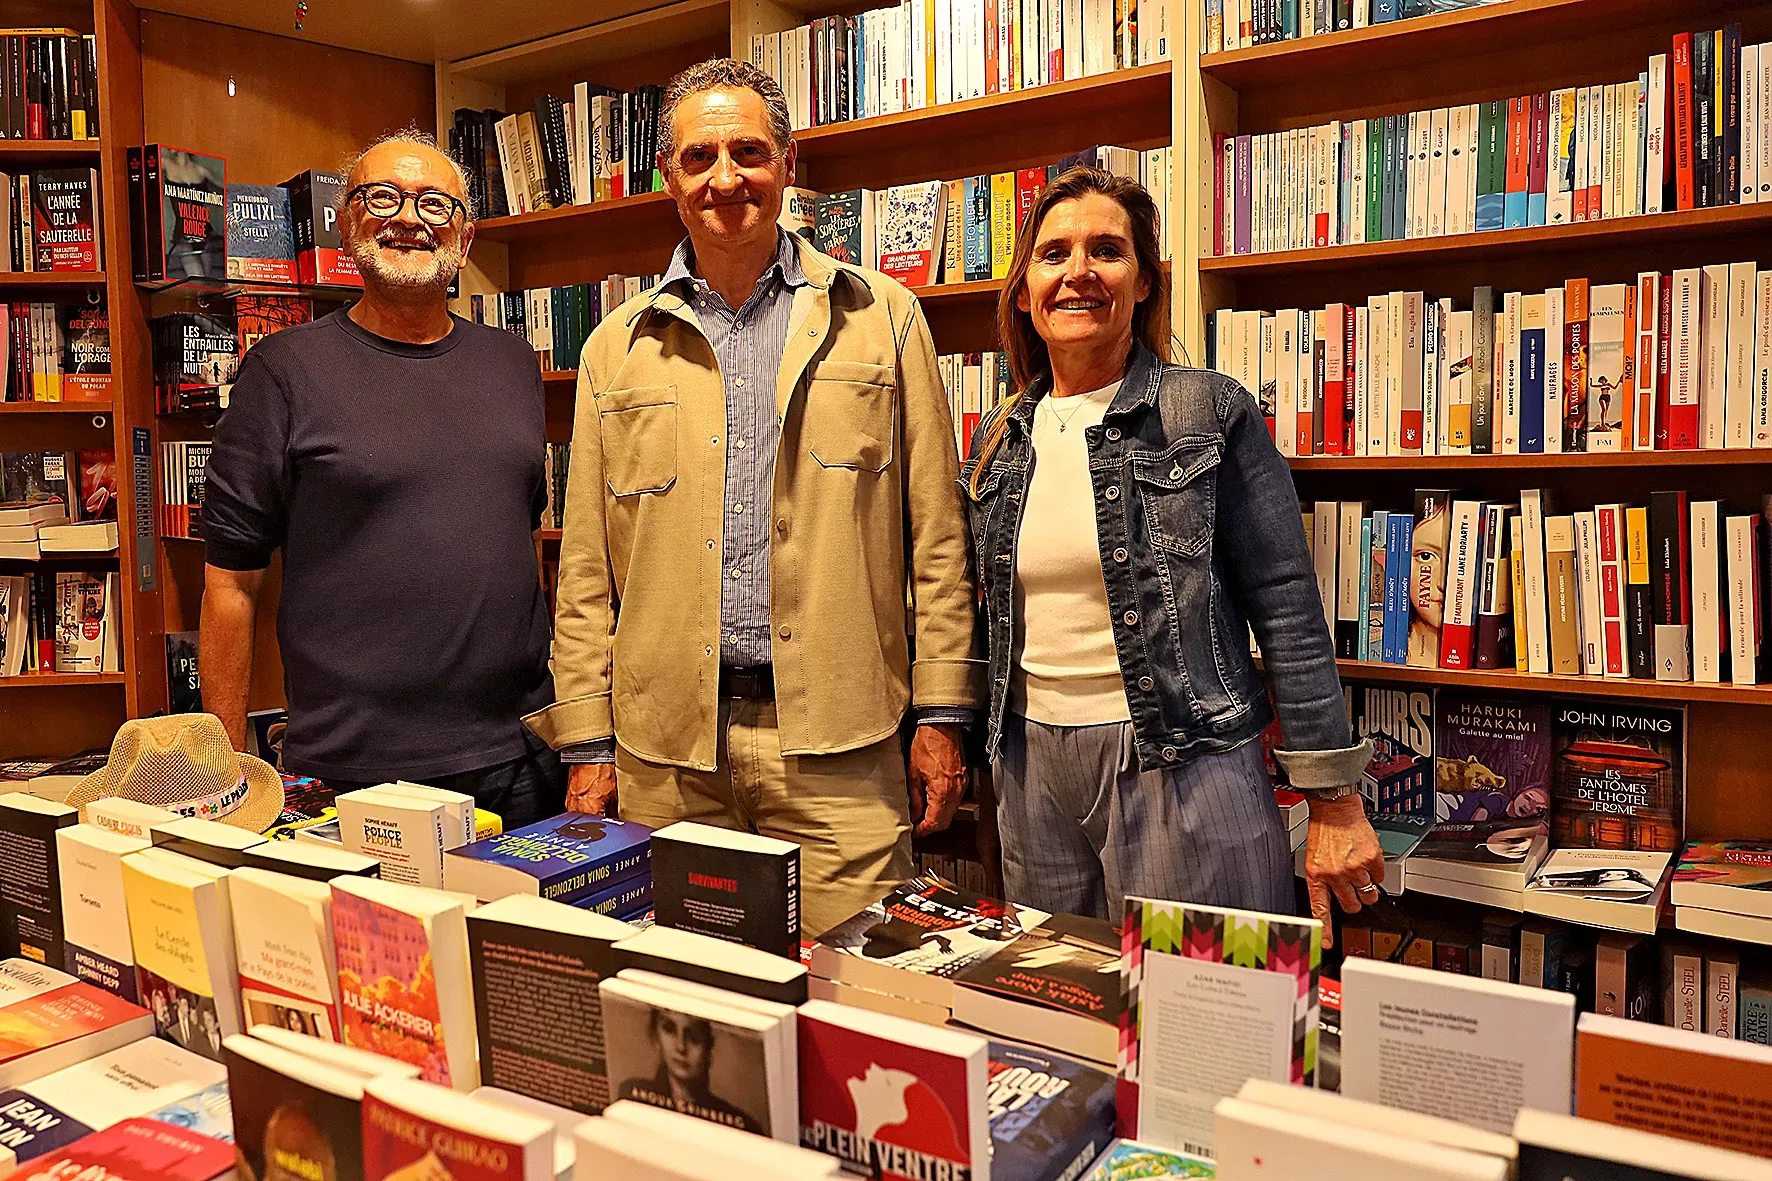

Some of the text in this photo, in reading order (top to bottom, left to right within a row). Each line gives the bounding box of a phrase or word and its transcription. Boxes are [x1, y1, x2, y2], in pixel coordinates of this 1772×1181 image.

[1729, 119, 1735, 127] Un
[39, 181, 88, 191] TERRY HAYES
[316, 176, 339, 186] FREIDA
[48, 192, 80, 210] L'ANNÉE
[164, 184, 223, 206] ANA MARTÍNEZ MUÑOZ
[236, 194, 269, 204] PIERGIORGIO
[53, 212, 78, 226] DE LA
[178, 202, 210, 222] VALENCE
[233, 203, 275, 220] PULIXI
[830, 215, 840, 223] LES
[40, 228, 92, 243] SAUTERELLE
[183, 219, 207, 237] ROUGE
[244, 227, 268, 238] STELLA
[946, 200, 955, 269] KEN FOLLETT
[966, 196, 976, 268] KEN FOLLETT
[994, 192, 1005, 265] KEN FOLLETT
[1005, 222, 1011, 231] du
[883, 259, 923, 270] DES LECTEURS
[886, 253, 921, 263] GRAND PRIX
[979, 256, 984, 264] La
[183, 325, 200, 338] LES
[1477, 304, 1487, 373] Michael Cunningham
[71, 343, 95, 354] NOIR
[183, 338, 234, 352] ENTRAILLES
[74, 353, 112, 363] L'ORAGE
[183, 351, 208, 362] DE LA
[183, 362, 202, 374] NUIT
[1571, 324, 1580, 414] LA MAISON DES PORTES
[1625, 356, 1633, 380] MOI?
[1509, 378, 1514, 386] DE
[1548, 362, 1558, 399] NAUFRAGÉS
[1457, 522, 1468, 576] LIANE MORIARTY
[1418, 565, 1432, 608] FAYNE
[1454, 578, 1465, 624] ET MAINTENANT
[1460, 703, 1523, 718] HARUKI
[1358, 688, 1432, 758] JOURS
[1447, 716, 1537, 732] MURAKAMI
[1559, 710, 1672, 733] JOHN IRVING
[1459, 727, 1524, 741] Galette au miel
[1605, 768, 1621, 780] LES
[1579, 776, 1647, 795] FANTÔMES
[1578, 788, 1649, 806] DE L'HOTEL
[1589, 801, 1637, 816] JEROME
[363, 825, 402, 841] POLICE
[380, 820, 398, 828] HÉNAFF
[366, 834, 402, 849] PEOPLE
[488, 834, 590, 863] DELZONGLE
[491, 844, 550, 863] SONJA
[615, 855, 640, 872] APNÉE
[543, 865, 610, 899] SONJA DELZONGLE
[621, 886, 645, 902] APNÉE
[595, 897, 617, 914] SONJA
[887, 908, 931, 928] MAURICE
[891, 902, 954, 929] GOUIRAN
[75, 952, 119, 978] AMBER HEARD
[77, 964, 120, 990] JOHNNY DEPP
[994, 975, 1105, 1010] Aslak Nore
[1680, 966, 1695, 1032] Danielle STEEL
[343, 990, 434, 1037] JULIE ACKERER
[1715, 973, 1730, 1038] Danielle STEEL
[2, 1099, 62, 1132] JEAN
[632, 1088, 746, 1129] ANOUK GRINBERG
[814, 1120, 971, 1181] PLEIN VENTRE
